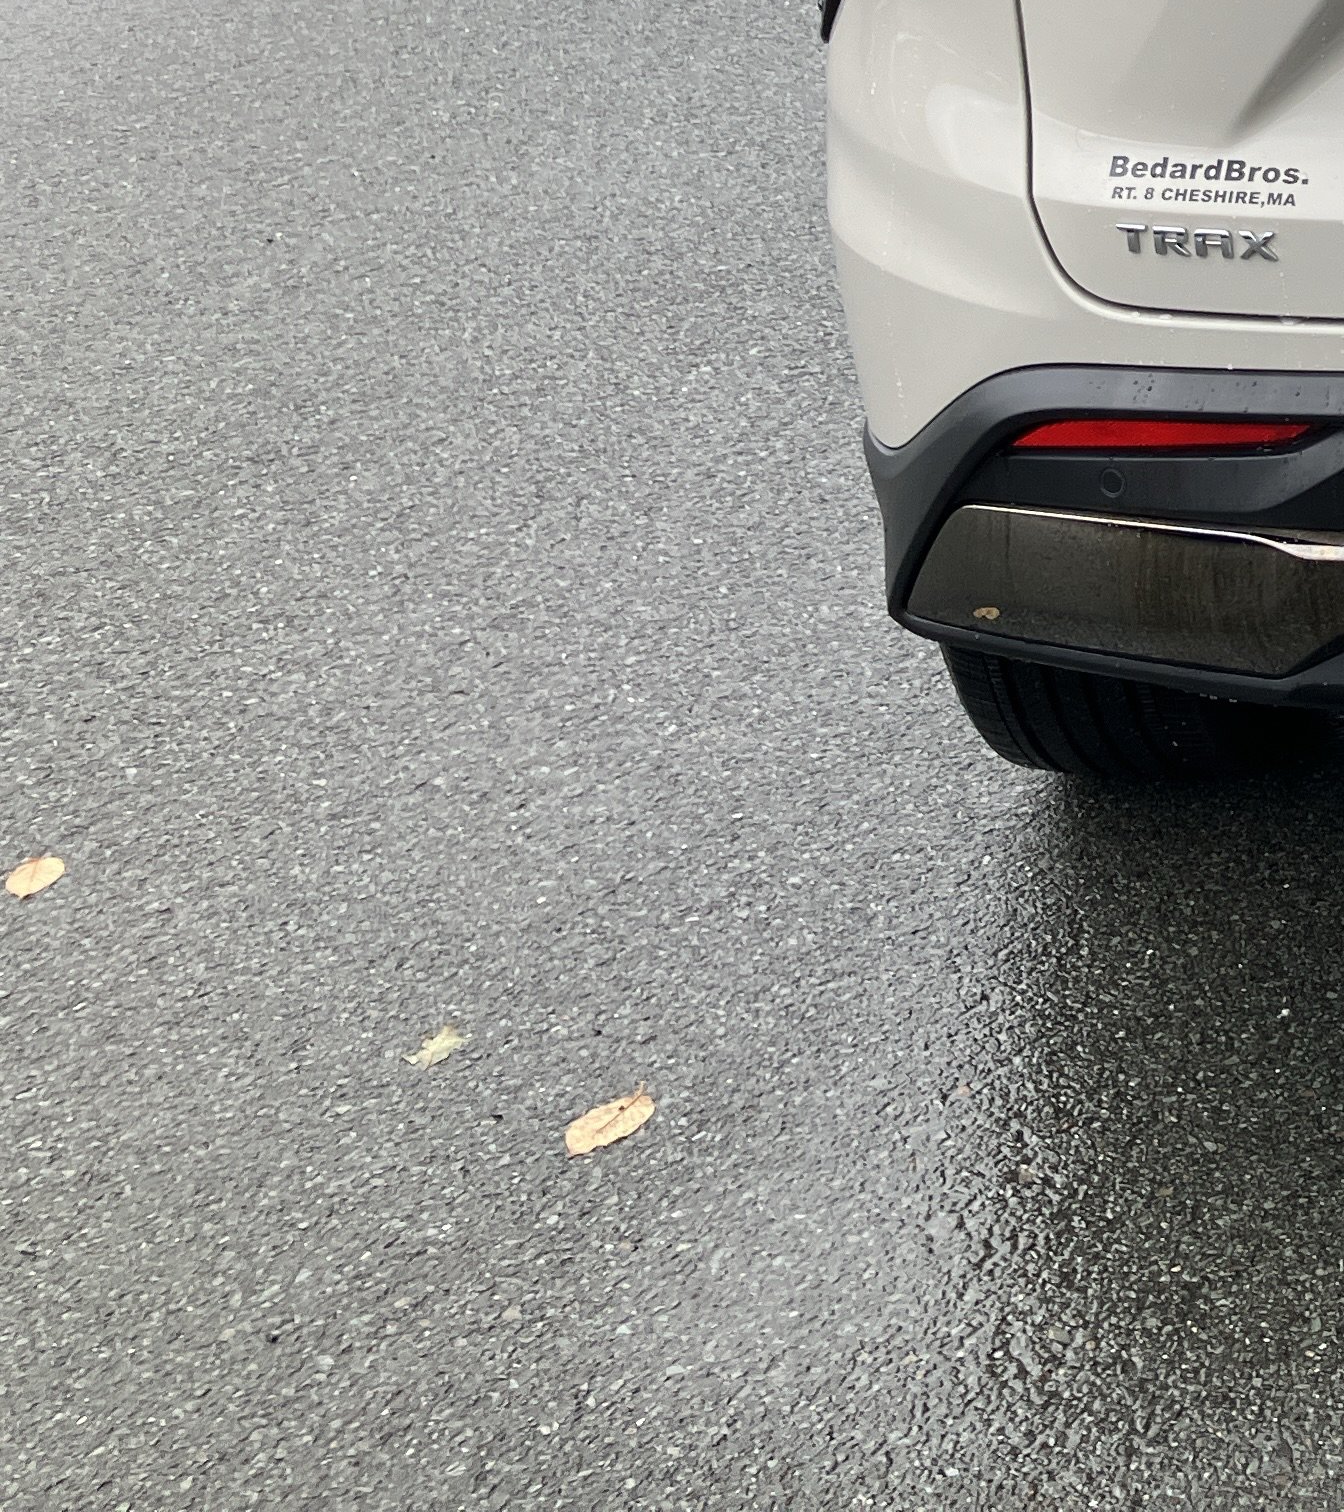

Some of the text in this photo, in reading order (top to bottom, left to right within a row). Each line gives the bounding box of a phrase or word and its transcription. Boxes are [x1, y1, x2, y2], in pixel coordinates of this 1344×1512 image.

[1109, 154, 1310, 186] BedardBros.
[1111, 186, 1138, 200] RT.
[1143, 187, 1155, 201] 8
[1115, 223, 1280, 262] TRAX
